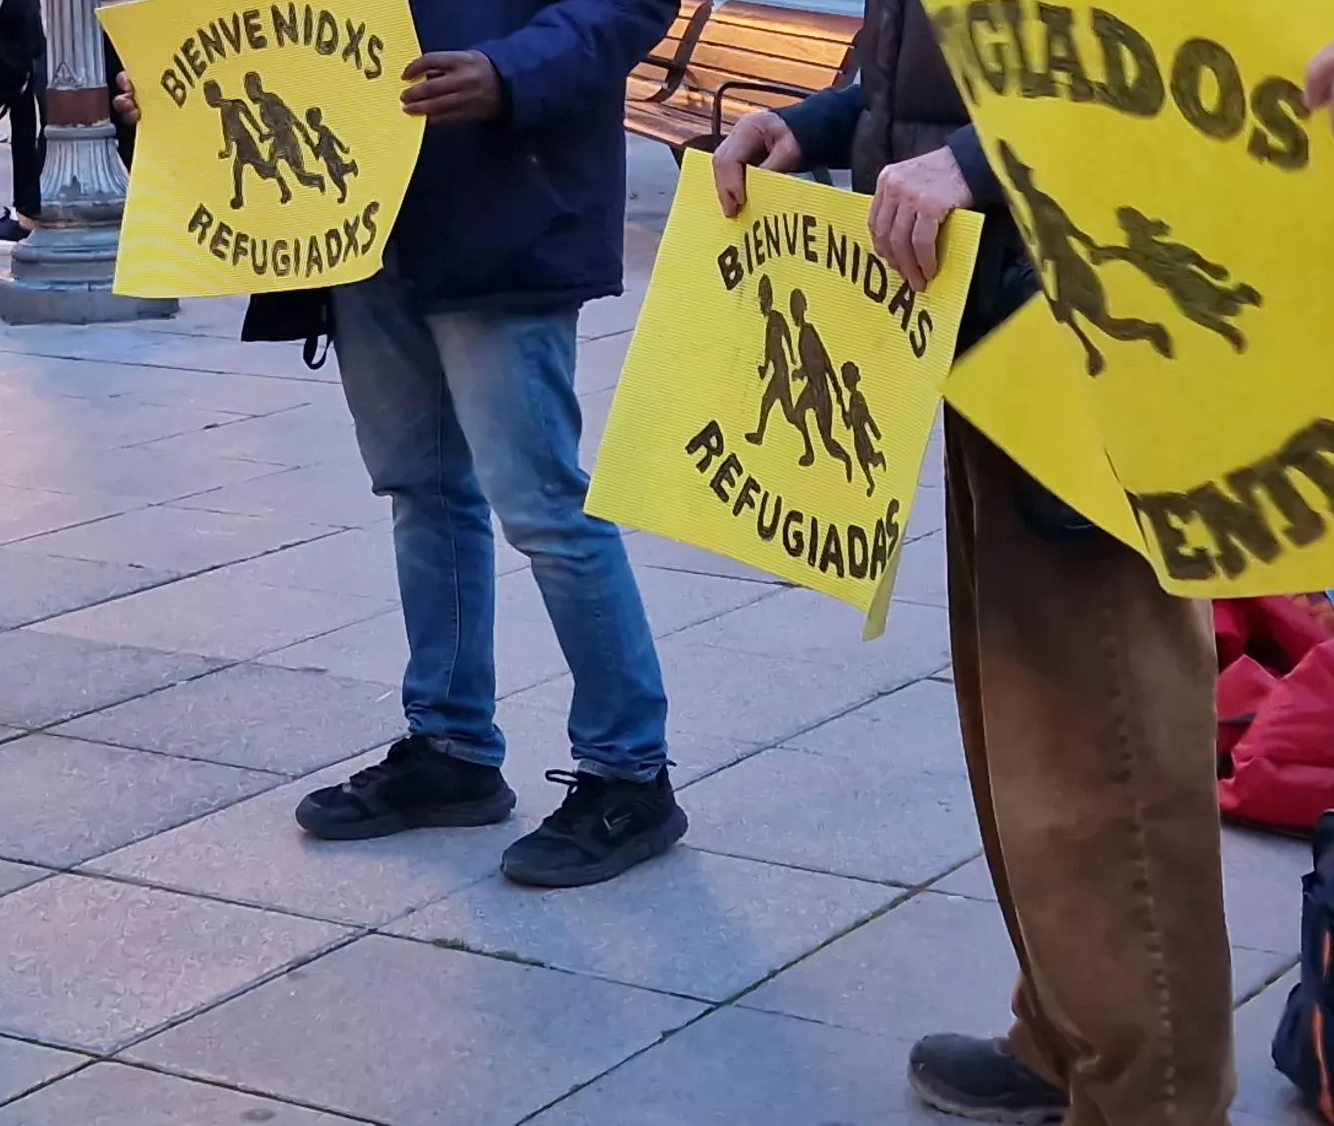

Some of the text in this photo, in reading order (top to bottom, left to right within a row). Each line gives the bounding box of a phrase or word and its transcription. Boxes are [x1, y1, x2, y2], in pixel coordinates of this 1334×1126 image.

[160, 1, 384, 109] BIENVENIDXS
[187, 200, 380, 278] REFUGIADXS
[717, 212, 934, 359] BIENVENIDAS
[684, 419, 901, 581] REFUGIADAS
